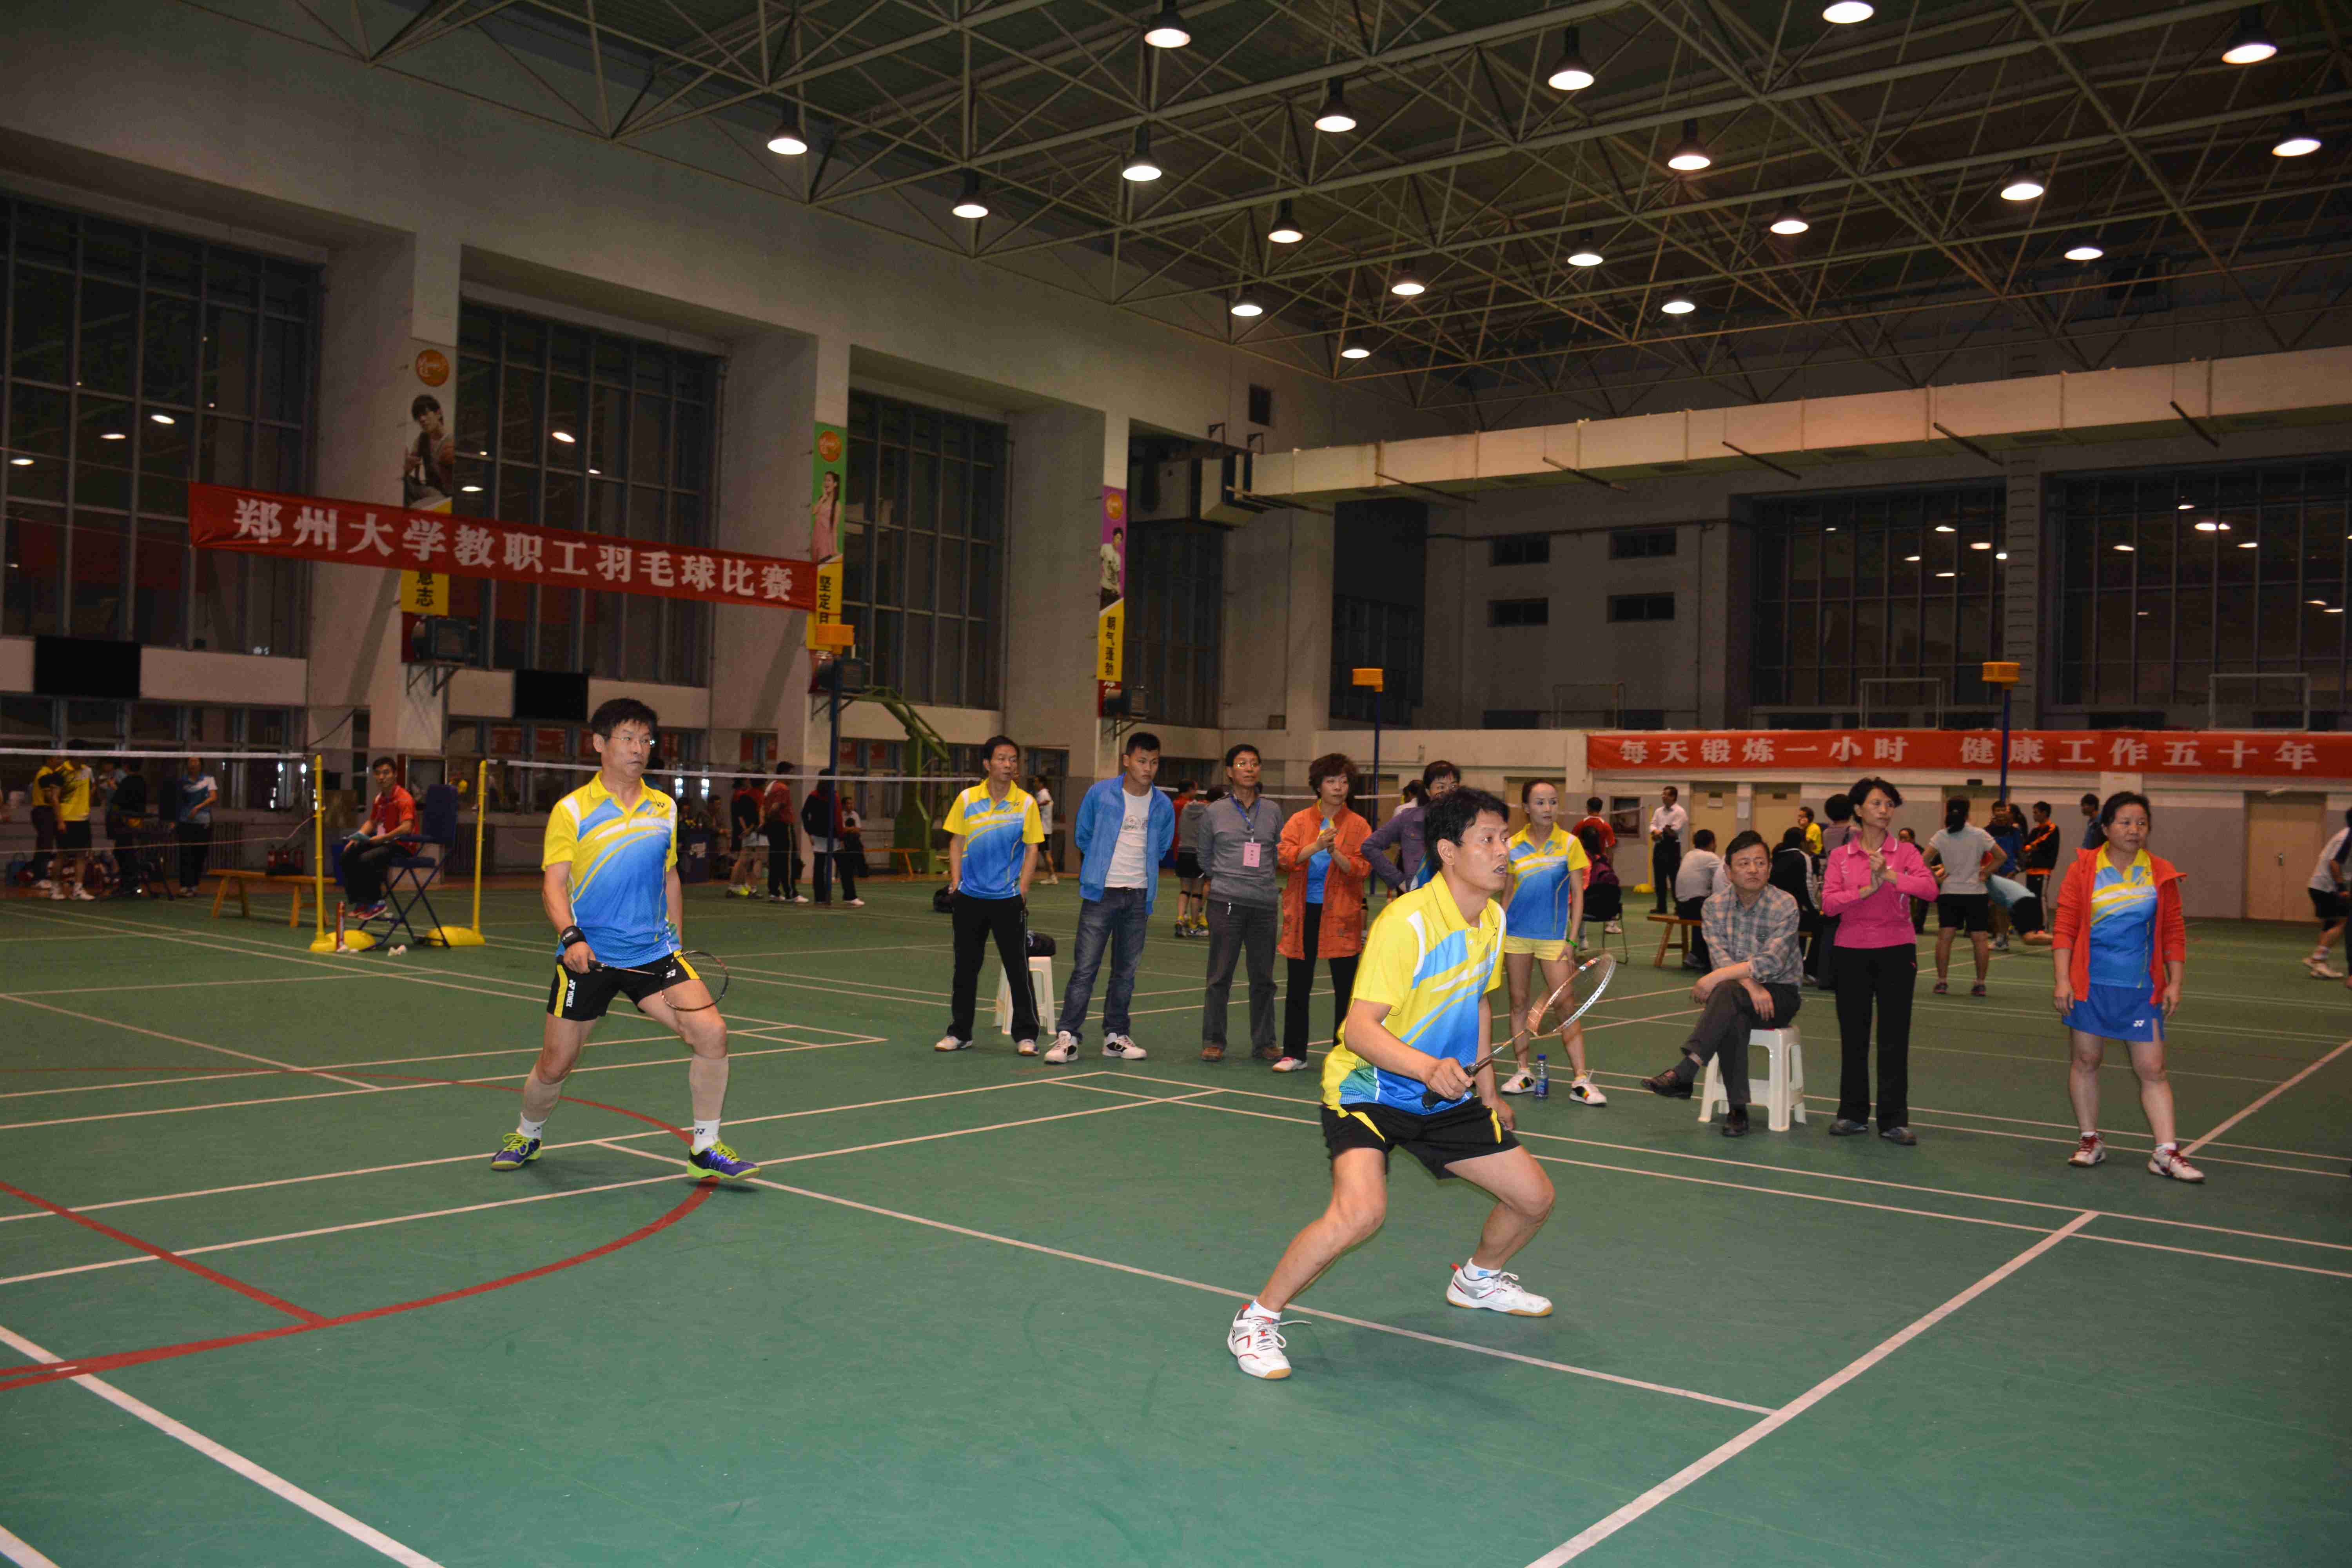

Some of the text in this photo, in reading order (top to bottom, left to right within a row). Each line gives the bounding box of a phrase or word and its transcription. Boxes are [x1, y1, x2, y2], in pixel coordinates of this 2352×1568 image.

[233, 498, 793, 602] 郑州大学教职工羽毛球比赛
[1619, 736, 2318, 770] 每天锻炼一小时 健康工作五十年
[566, 990, 575, 1008] YONEX
